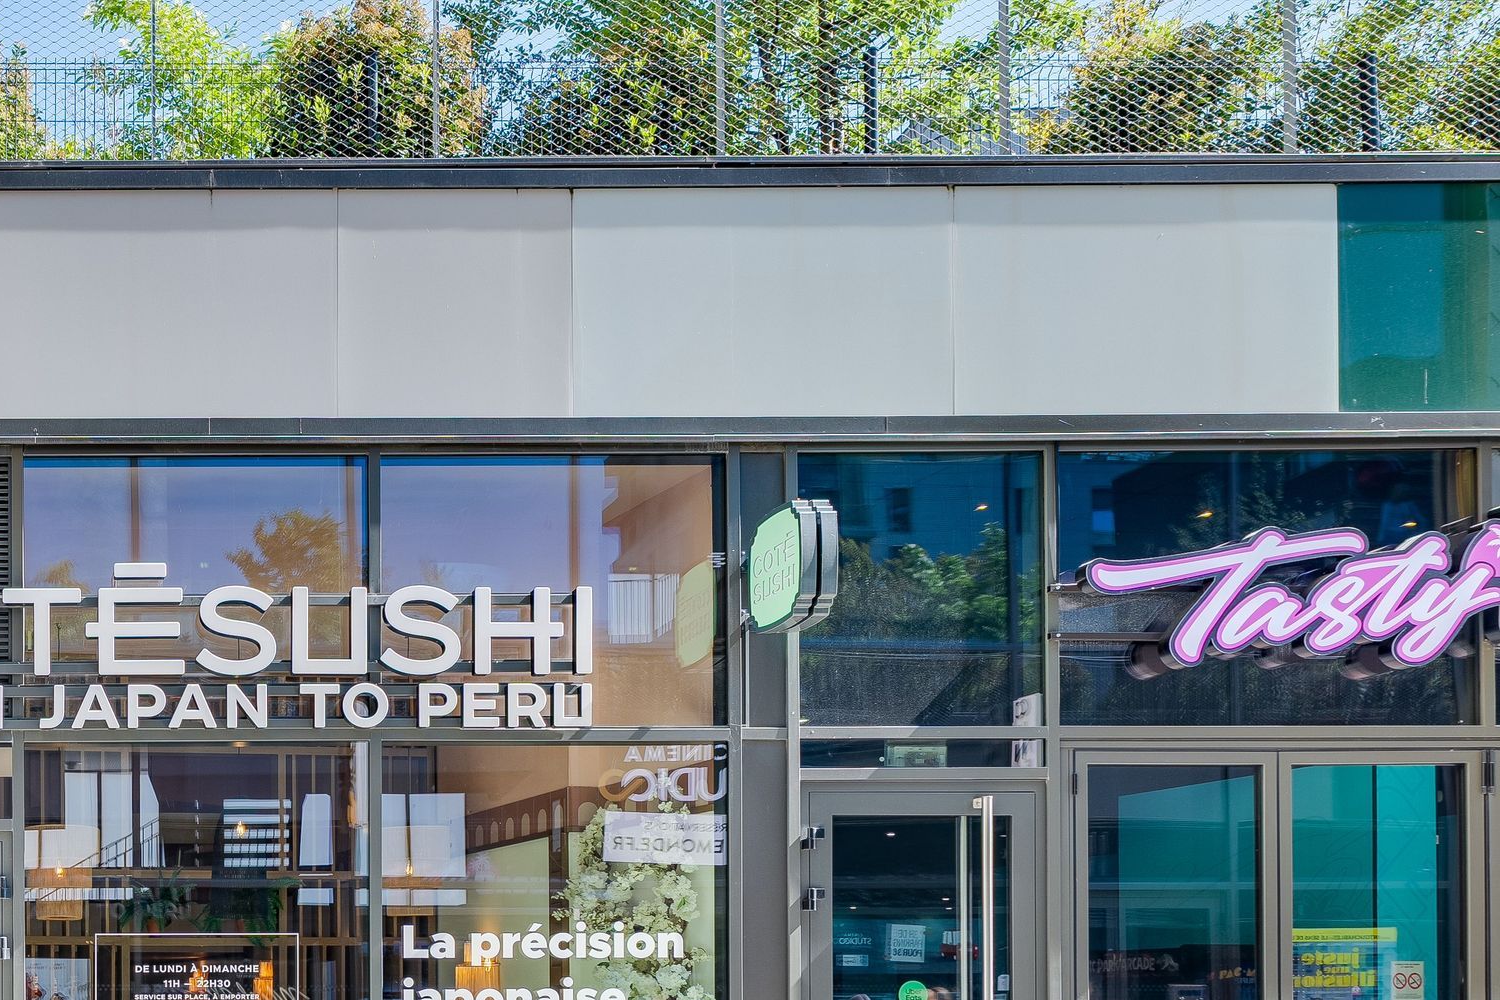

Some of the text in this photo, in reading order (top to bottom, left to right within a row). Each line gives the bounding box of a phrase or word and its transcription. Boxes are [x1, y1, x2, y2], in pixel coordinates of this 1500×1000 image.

[753, 563, 796, 605] SUSHI
[1087, 527, 1500, 667] Tasty
[40, 684, 269, 730] JAPAN
[300, 684, 389, 729] TO
[403, 921, 685, 966] La précision
[135, 962, 259, 973] DE LUNDI À DIMANCHE
[163, 979, 180, 988] 11H
[196, 979, 231, 988] 22H30
[213, 992, 218, 1000] À
